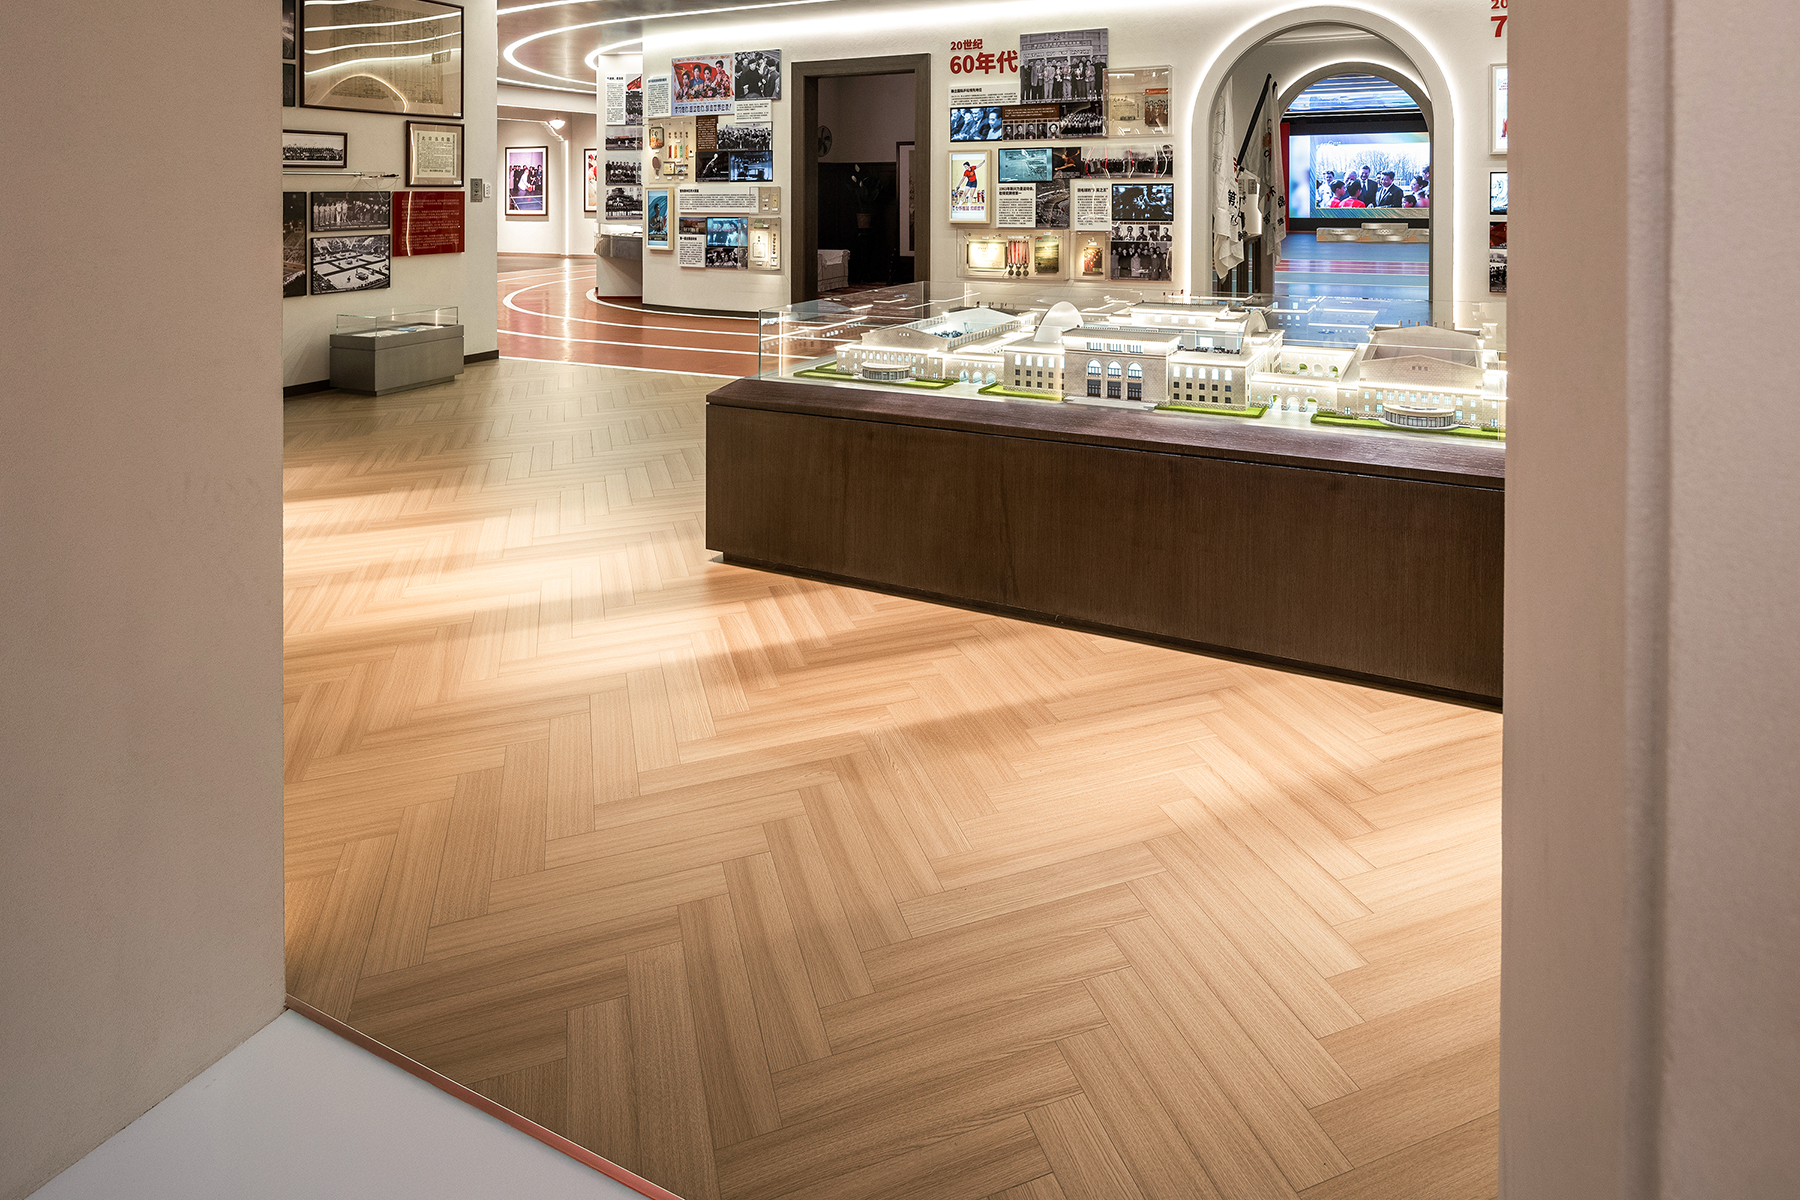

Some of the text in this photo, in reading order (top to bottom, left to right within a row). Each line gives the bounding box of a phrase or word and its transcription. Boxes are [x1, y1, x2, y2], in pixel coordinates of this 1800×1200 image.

[1490, 15, 1508, 38] 7
[950, 38, 984, 51] 20世纪
[949, 49, 1019, 75] 60年代
